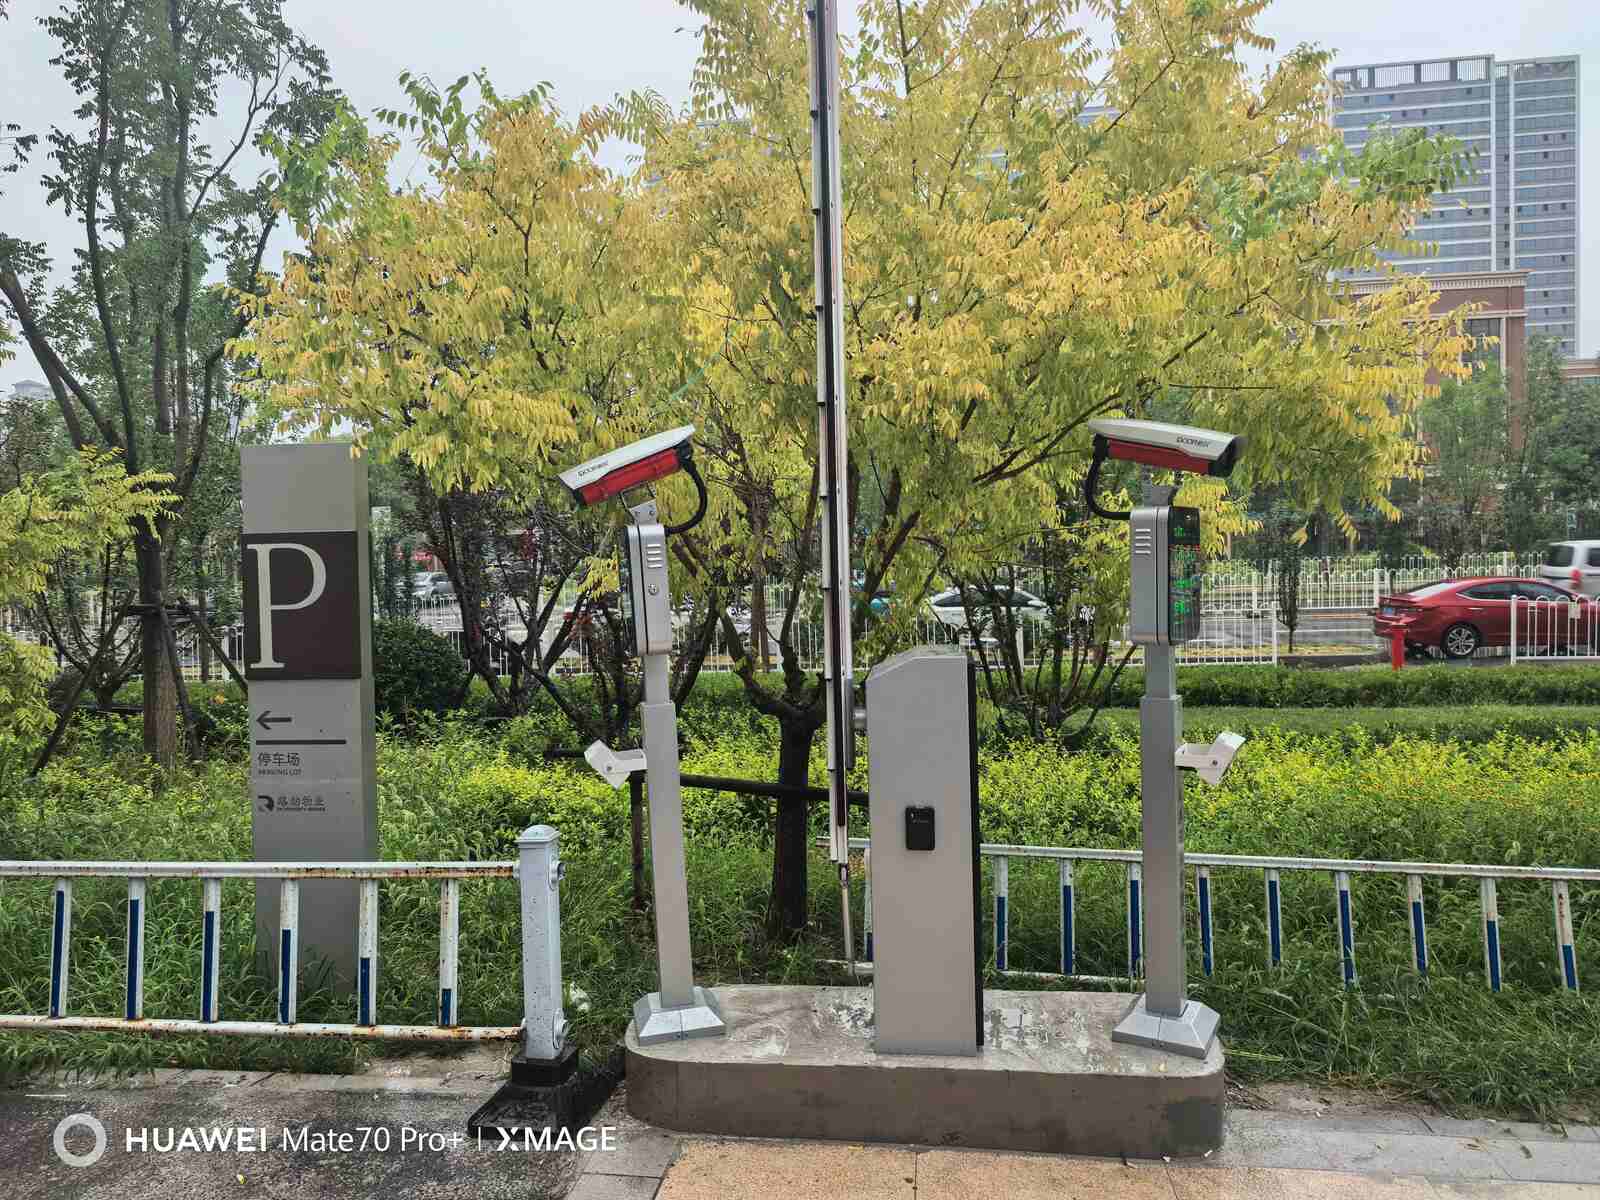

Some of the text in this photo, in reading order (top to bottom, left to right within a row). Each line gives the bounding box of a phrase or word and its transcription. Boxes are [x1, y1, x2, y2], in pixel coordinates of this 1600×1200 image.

[247, 542, 327, 669] P
[258, 752, 301, 767] 停车场
